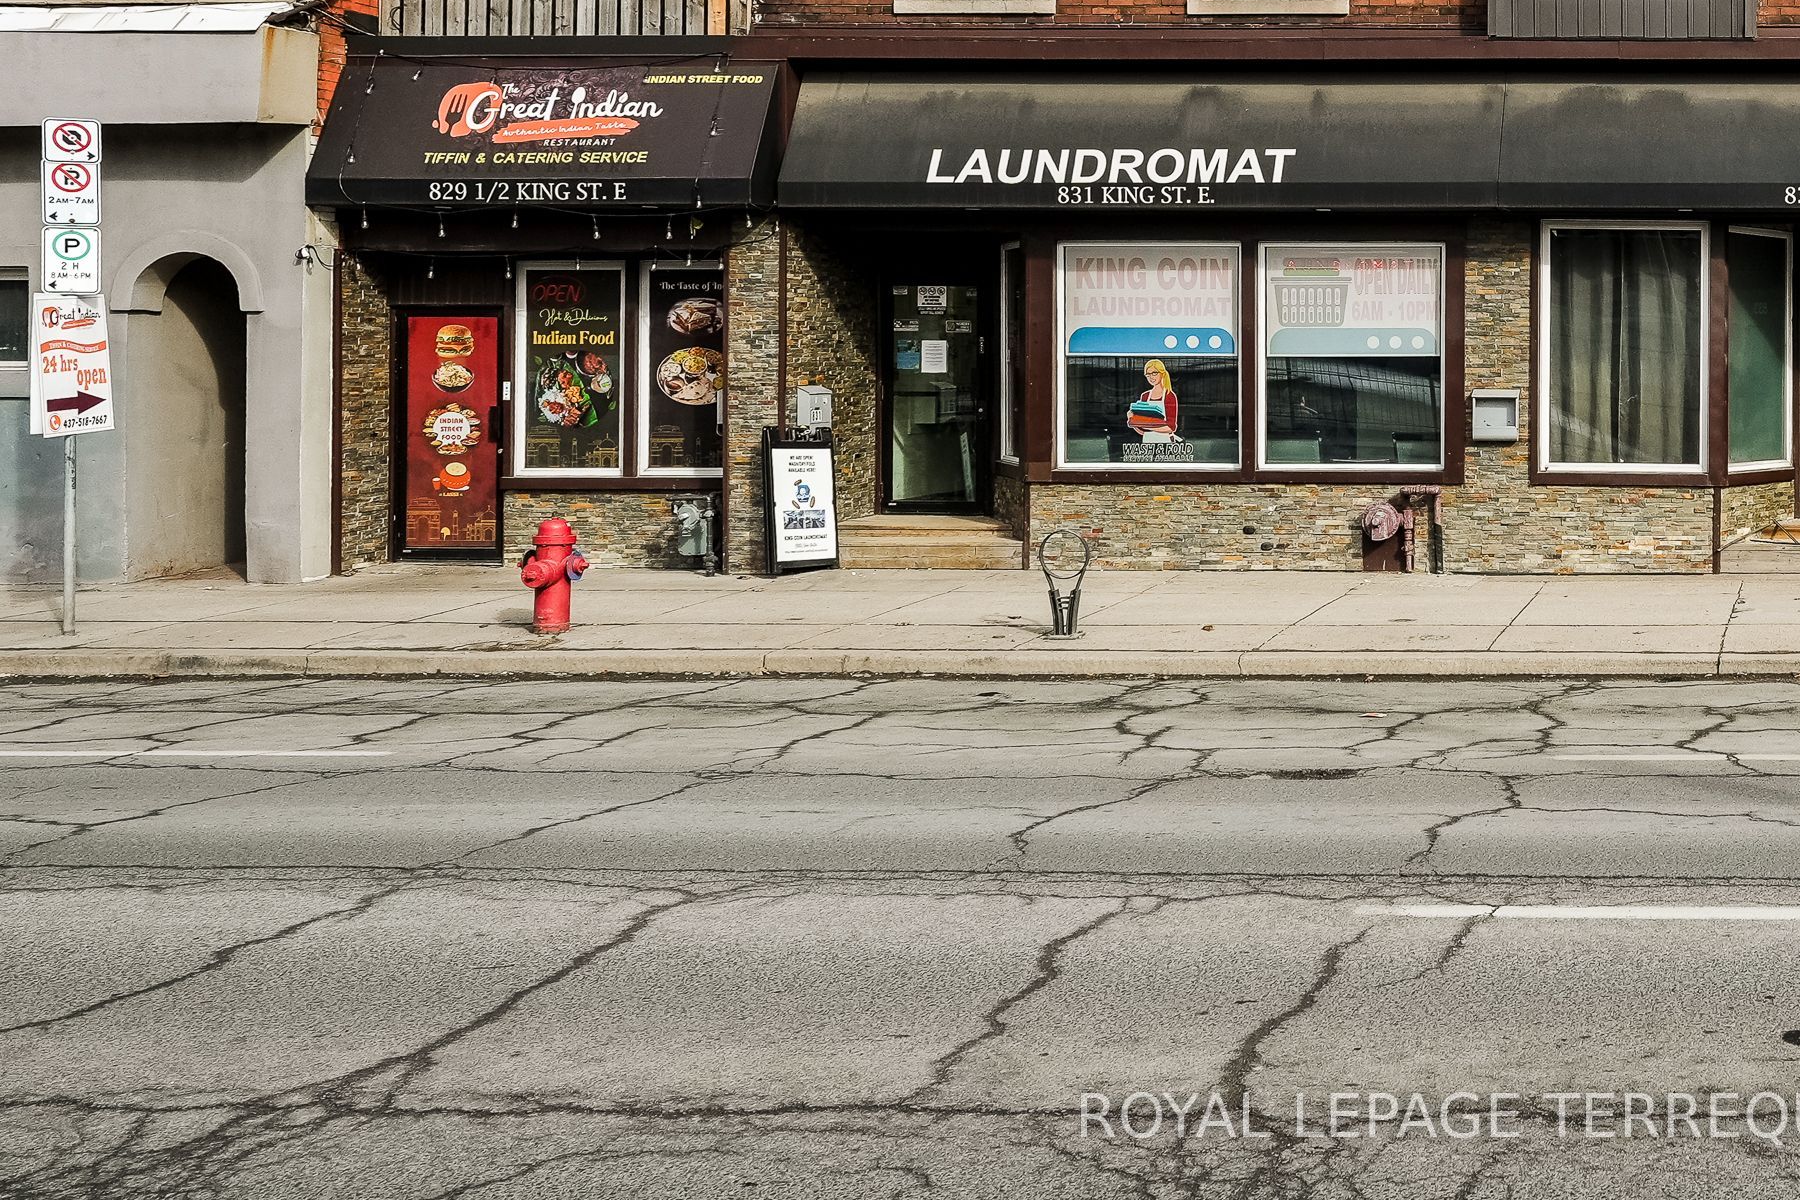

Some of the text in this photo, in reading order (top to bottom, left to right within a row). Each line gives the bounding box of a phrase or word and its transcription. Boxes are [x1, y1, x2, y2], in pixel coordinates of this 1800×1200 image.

[647, 75, 763, 84] INDIAN STREET FOOD
[502, 84, 521, 99] The
[465, 86, 664, 130] Great Indian
[502, 122, 628, 138] Authentic Indian Taste
[543, 138, 616, 147] RESTAURANT
[424, 151, 649, 165] TIFFIN & CATERING SERVICE
[926, 148, 1297, 184] LAUNDROMAT
[429, 181, 627, 202] 829 1/2 KING ST. E
[1057, 186, 1215, 204] 831 KING ST. E.
[61, 261, 80, 270] 2 H
[1075, 257, 1229, 290] KING COIN
[1354, 258, 1392, 295] OPEN
[532, 285, 581, 303] OPEN
[660, 281, 724, 292] The Taste of In
[1073, 296, 1231, 317] LAUNDROMAT
[1352, 301, 1384, 321] 6AM
[533, 330, 615, 345] Indian Food
[43, 354, 79, 373] 24 hrs
[77, 368, 107, 390] open
[1122, 443, 1194, 456] WASH & FOLD
